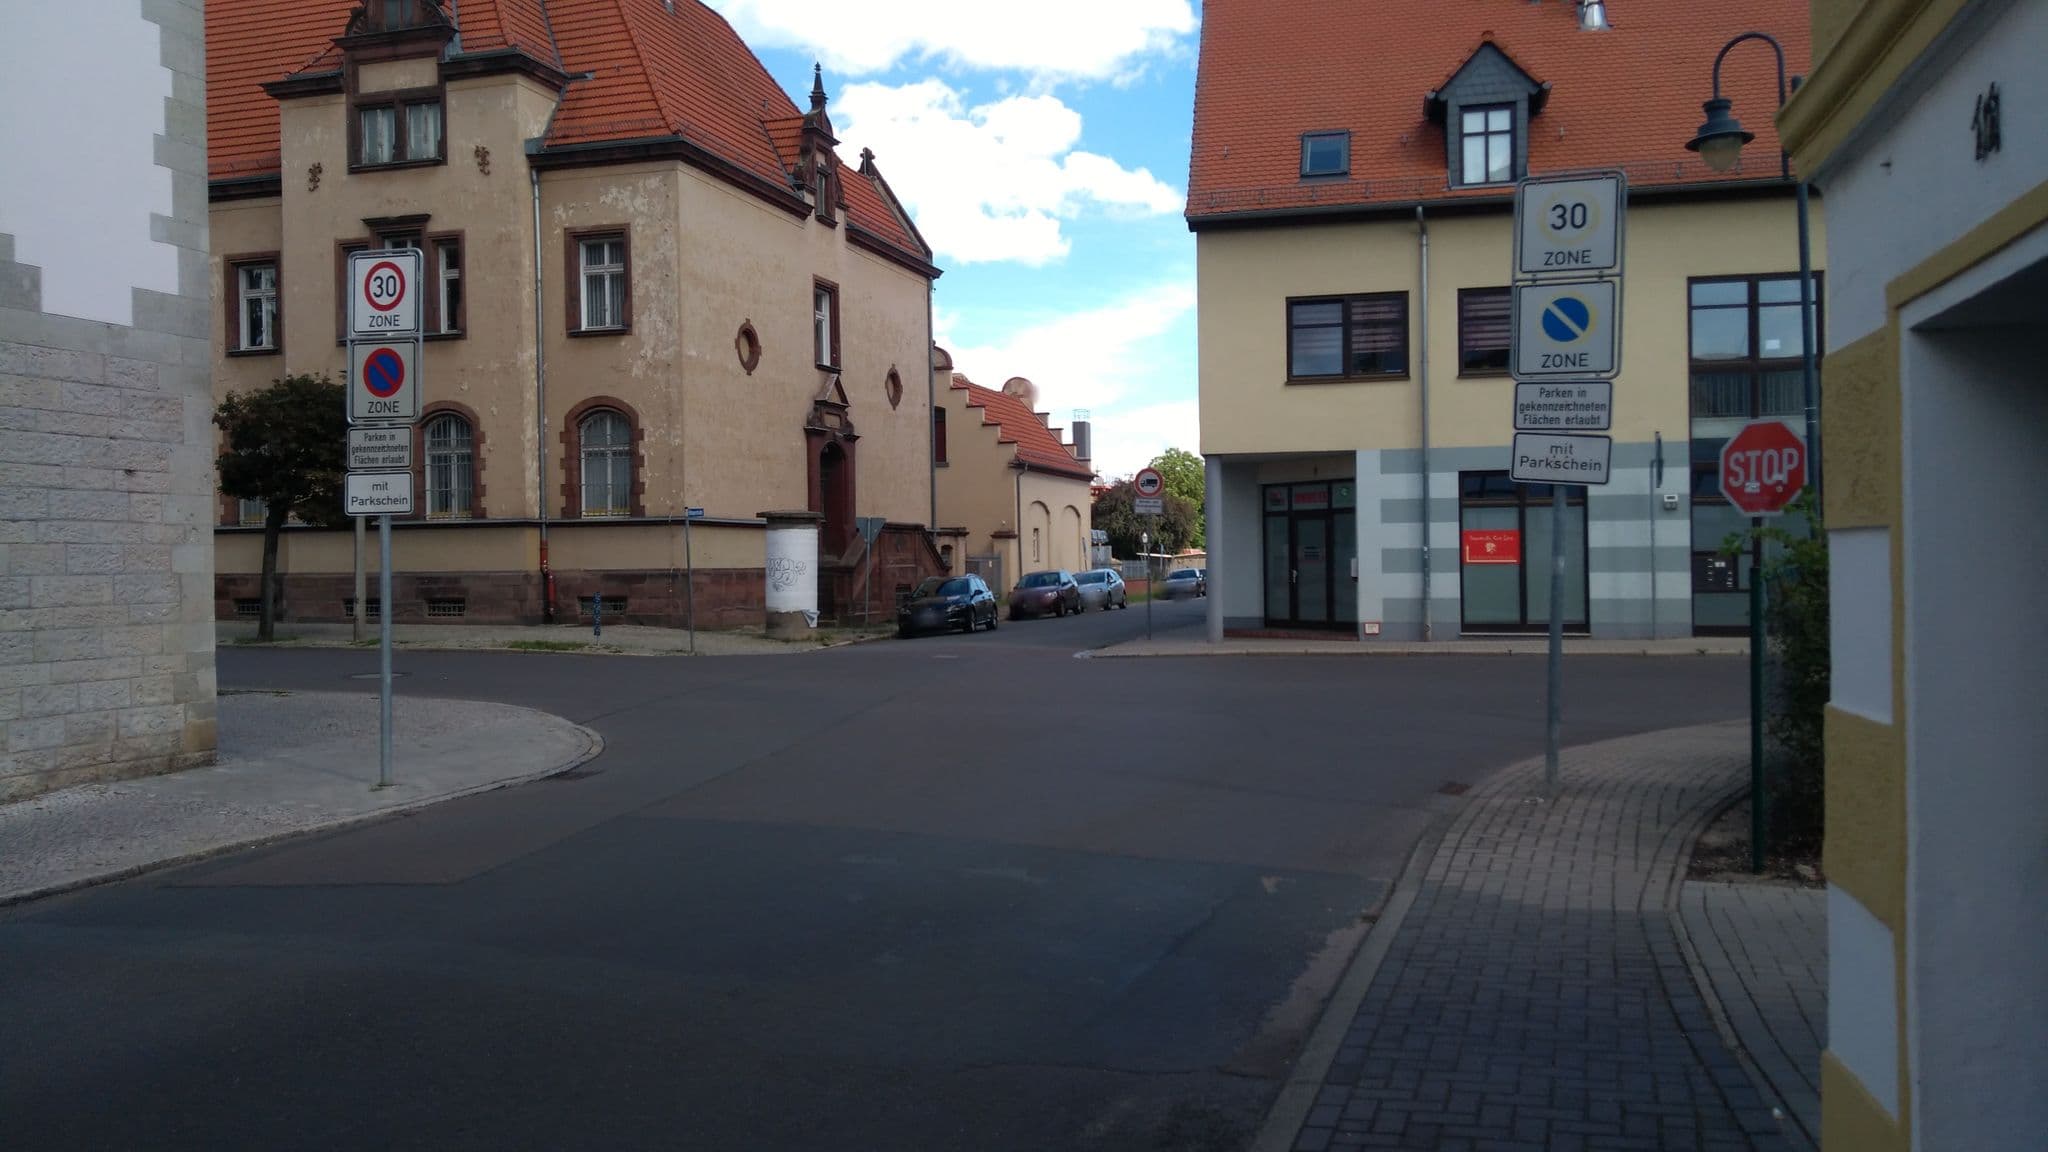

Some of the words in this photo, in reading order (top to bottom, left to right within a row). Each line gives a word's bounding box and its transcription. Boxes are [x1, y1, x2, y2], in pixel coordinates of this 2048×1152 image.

[1551, 203, 1587, 230] 30
[1543, 250, 1592, 266] ZONE
[373, 275, 397, 298] 30
[369, 314, 401, 328] ZONE
[1541, 353, 1589, 369] ZONE
[1539, 387, 1573, 398] Parken
[1578, 387, 1587, 398] in
[367, 401, 400, 414] ZONE
[1519, 401, 1607, 414] gekennzeichneten
[1523, 414, 1560, 425] Flächen
[1565, 414, 1601, 425] erlaubt
[364, 432, 387, 442] Parken
[389, 433, 396, 441] in
[351, 444, 409, 456] gekennzeichneten
[1550, 442, 1574, 455] mit
[354, 455, 380, 465] Flächen
[382, 455, 405, 464] erlaubt
[1519, 455, 1602, 472] Parkschein
[1728, 447, 1800, 488] STOP
[371, 481, 389, 491] mit
[351, 495, 409, 506] Parkschein
